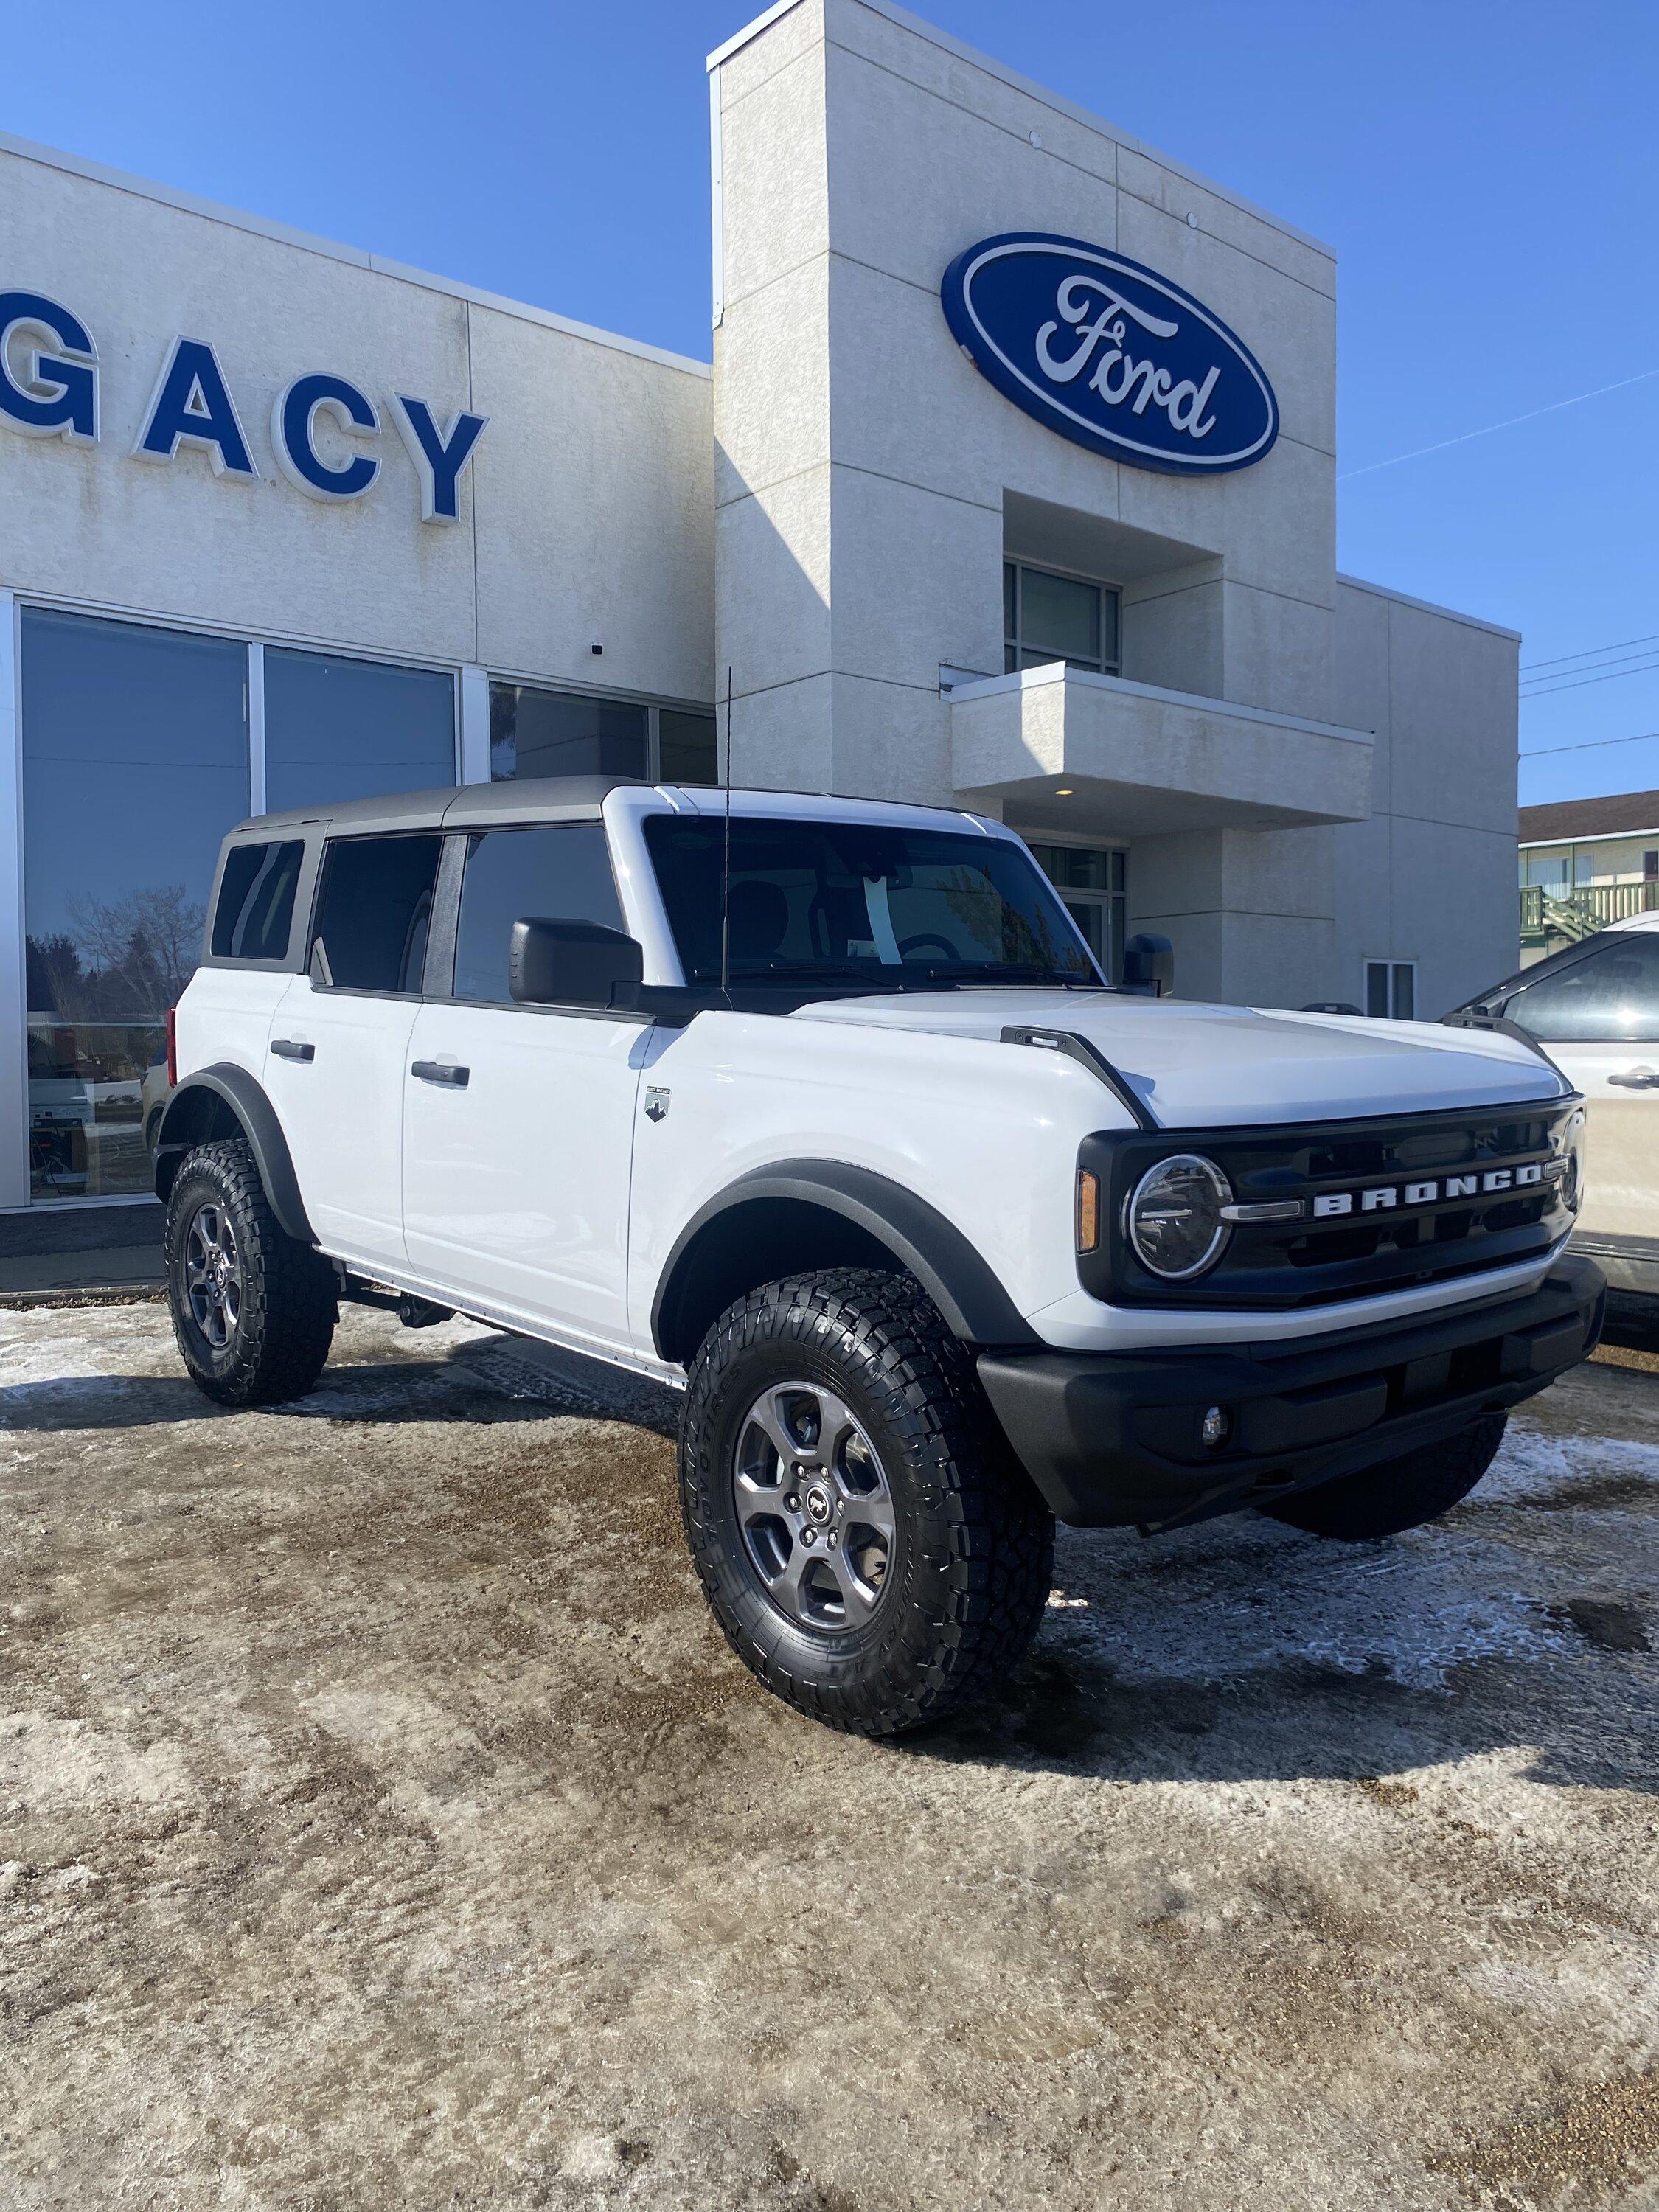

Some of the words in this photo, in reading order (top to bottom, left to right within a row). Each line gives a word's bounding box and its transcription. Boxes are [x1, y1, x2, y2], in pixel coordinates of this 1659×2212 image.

[0, 288, 490, 526] GACY
[1036, 275, 1221, 439] Ford
[1313, 1164, 1542, 1217] BRONCO
